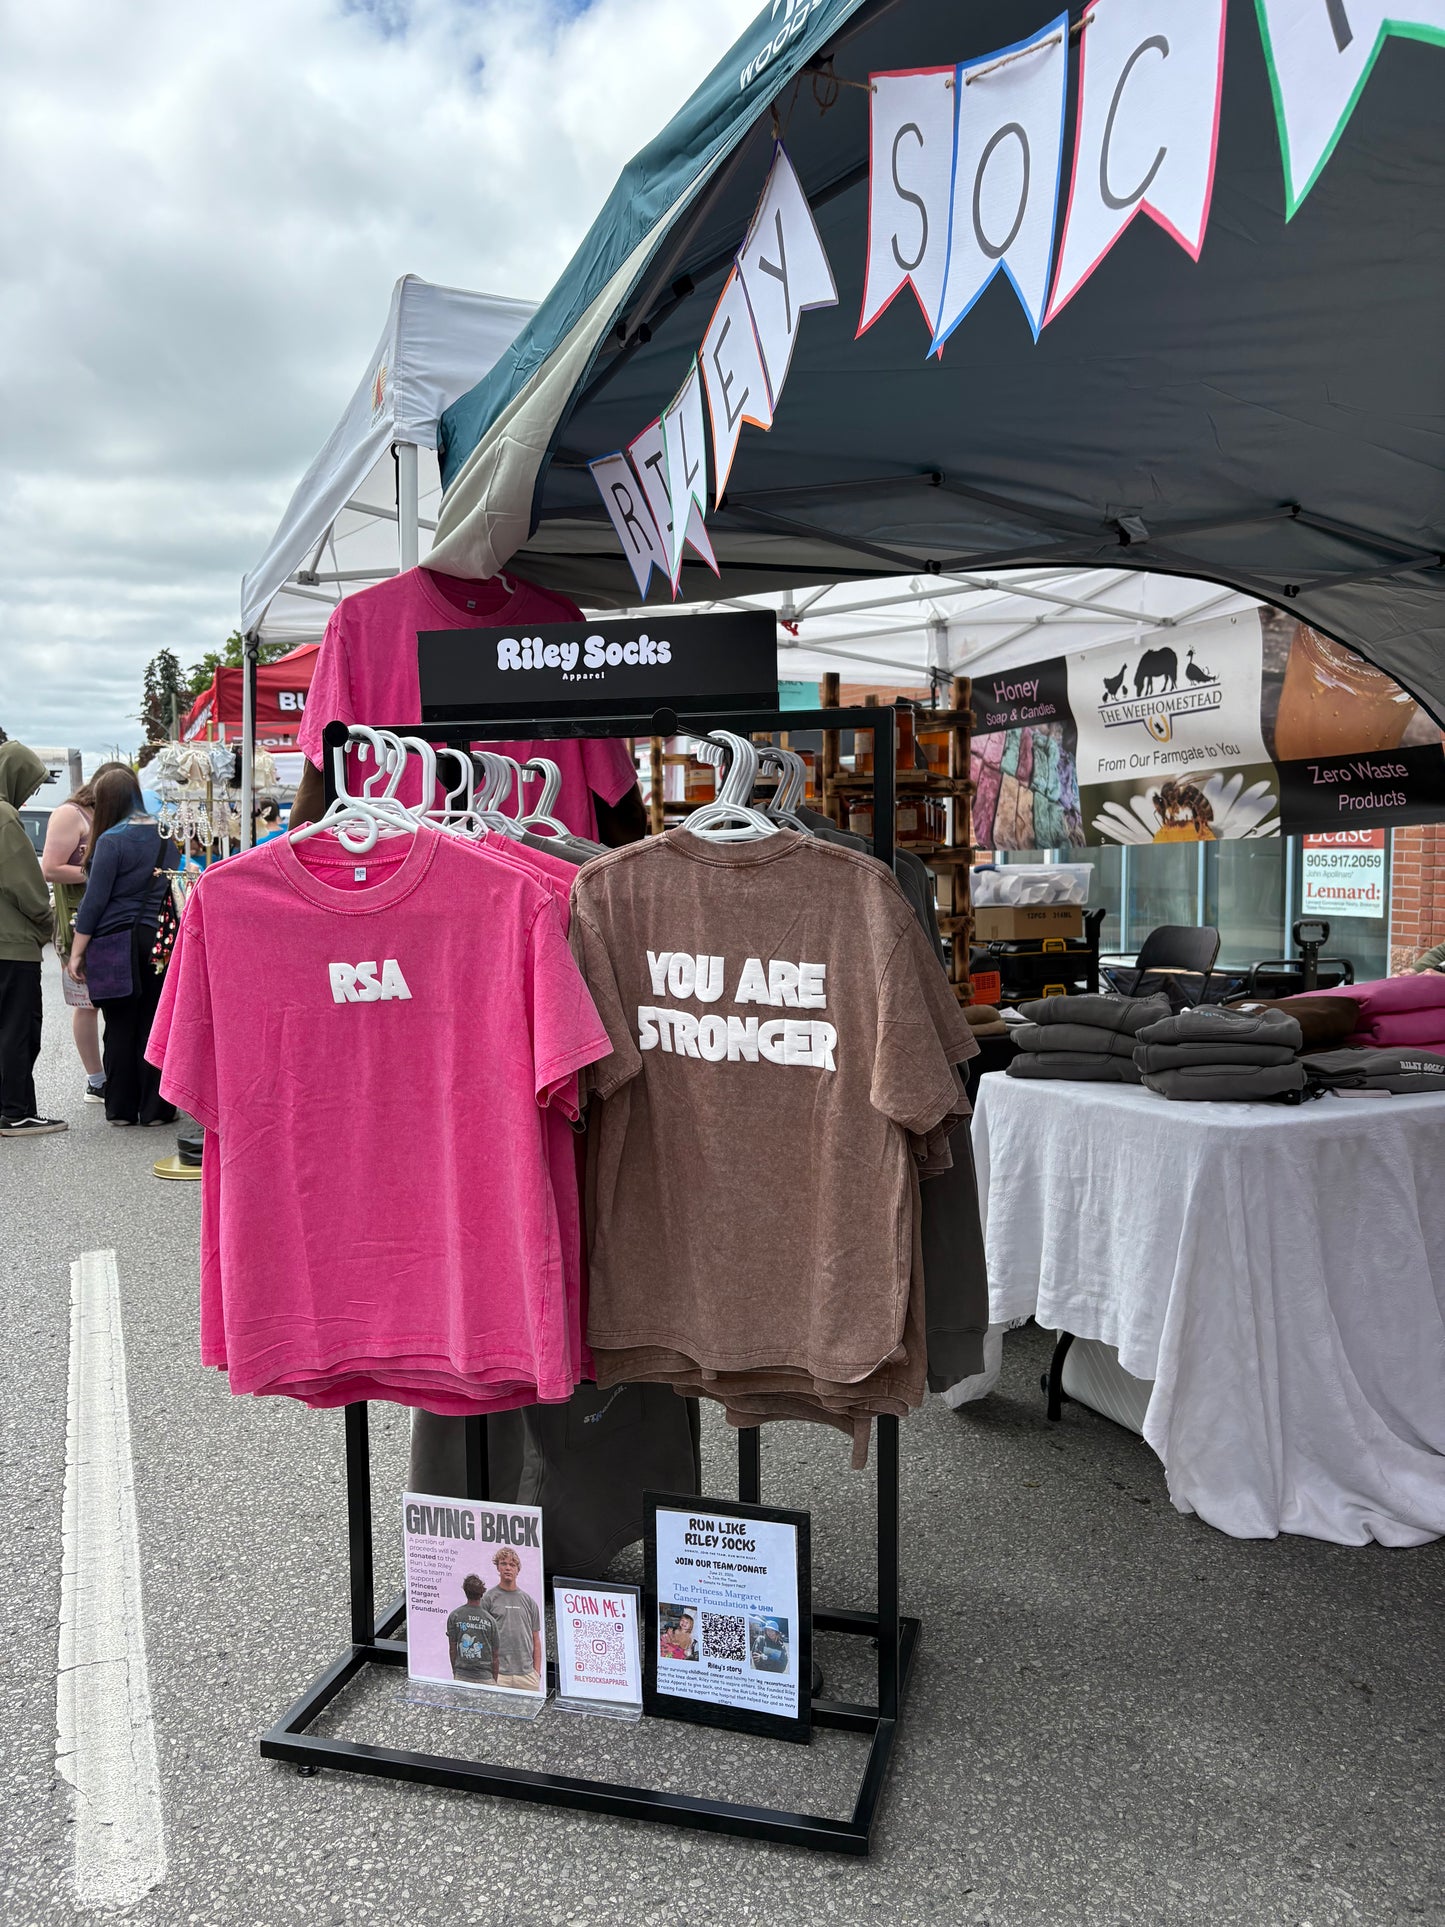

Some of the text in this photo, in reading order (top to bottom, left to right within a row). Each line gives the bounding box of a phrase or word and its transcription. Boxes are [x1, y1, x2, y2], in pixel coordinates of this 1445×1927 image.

[740, 0, 823, 90] WOOD
[496, 634, 672, 671] Riley Socks
[562, 672, 605, 681] Apparel
[993, 677, 1040, 705] Honey
[986, 702, 1056, 727] Soap & Candles
[1098, 690, 1223, 724] THE WEEHOMESTEAD
[1098, 742, 1241, 773] From Our Farmgate to You
[1307, 761, 1409, 785] Zero Waste
[1338, 789, 1407, 812] Products
[1306, 855, 1381, 868] 905.917.2059
[1306, 883, 1380, 900] Lennard:
[328, 959, 413, 1004] RSA
[646, 950, 827, 1009] YOU ARE
[637, 1005, 838, 1071] STRONGER
[1400, 1061, 1445, 1073] RILEY SOCKS
[406, 1504, 540, 1548] GIVING BACK
[689, 1518, 747, 1536] RUN LIKE
[410, 1545, 437, 1553] proceeds
[685, 1533, 756, 1552] RILEY SOCKS
[410, 1552, 436, 1560] donated
[674, 1556, 768, 1575] JOIN OUR TEAM/DONATE
[410, 1575, 434, 1583] support
[411, 1582, 437, 1590] Princess
[411, 1590, 440, 1598] Margaret
[673, 1583, 762, 1601] The Princess Margaret
[411, 1605, 448, 1614] Foundation
[564, 1593, 626, 1618] SCAN ME!
[673, 1593, 701, 1604] Cancer
[703, 1596, 749, 1610] Foundation
[707, 1662, 742, 1674] Riley's story
[574, 1675, 629, 1687] RILEYSOCKSAPPAREL
[764, 1680, 795, 1688] reconstructed
